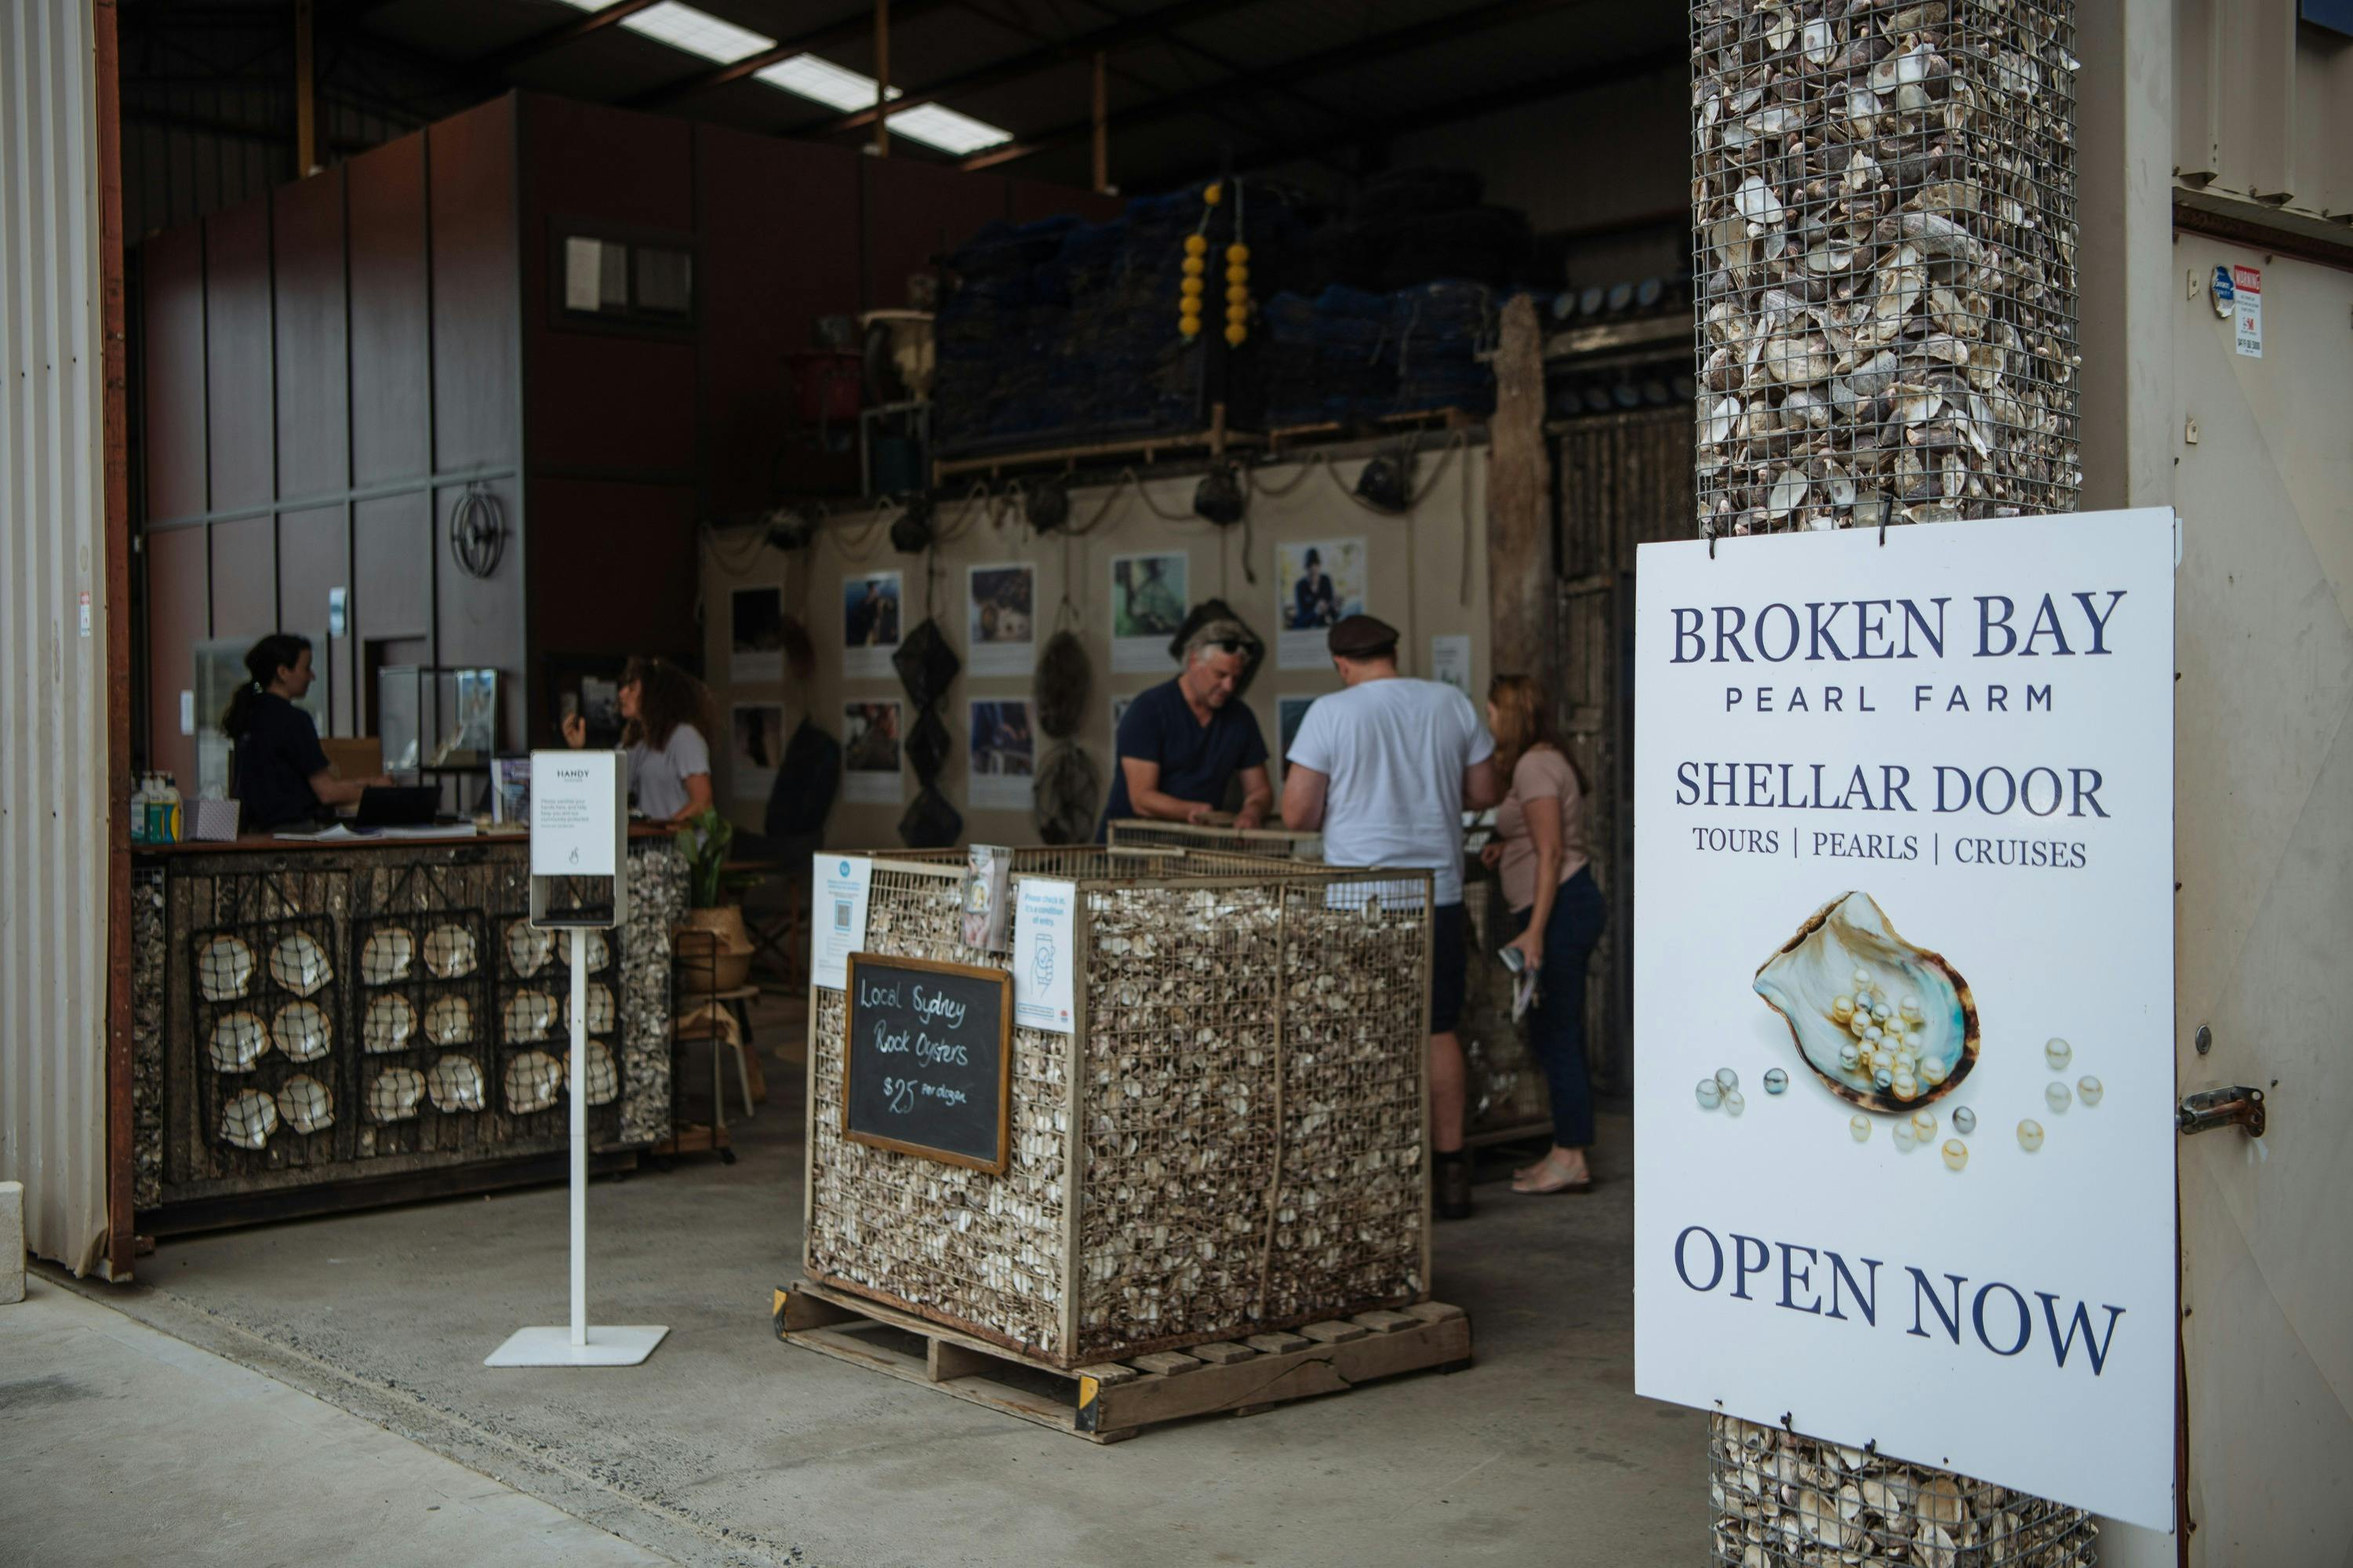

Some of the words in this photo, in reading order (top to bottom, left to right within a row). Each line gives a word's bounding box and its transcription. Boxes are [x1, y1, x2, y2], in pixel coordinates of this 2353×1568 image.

[1670, 598, 1951, 663] BROKEN
[1973, 591, 2127, 657] BAY
[1726, 686, 1875, 712] PEARL
[1915, 684, 2052, 712] FARM
[1676, 761, 1917, 811] SHELLAR
[1933, 766, 2111, 818] DOOR
[1693, 828, 1779, 854] TOURS
[1813, 832, 1918, 860] PEARLS
[1955, 838, 2086, 869] CRUISES
[860, 979, 901, 1008] Local
[912, 985, 966, 1029] Sydney
[874, 1019, 911, 1053] Rock
[915, 1031, 968, 1068] Oysters
[883, 1077, 918, 1114] $25
[1674, 1225, 1884, 1327] OPEN
[1904, 1265, 2126, 1377] NOW
